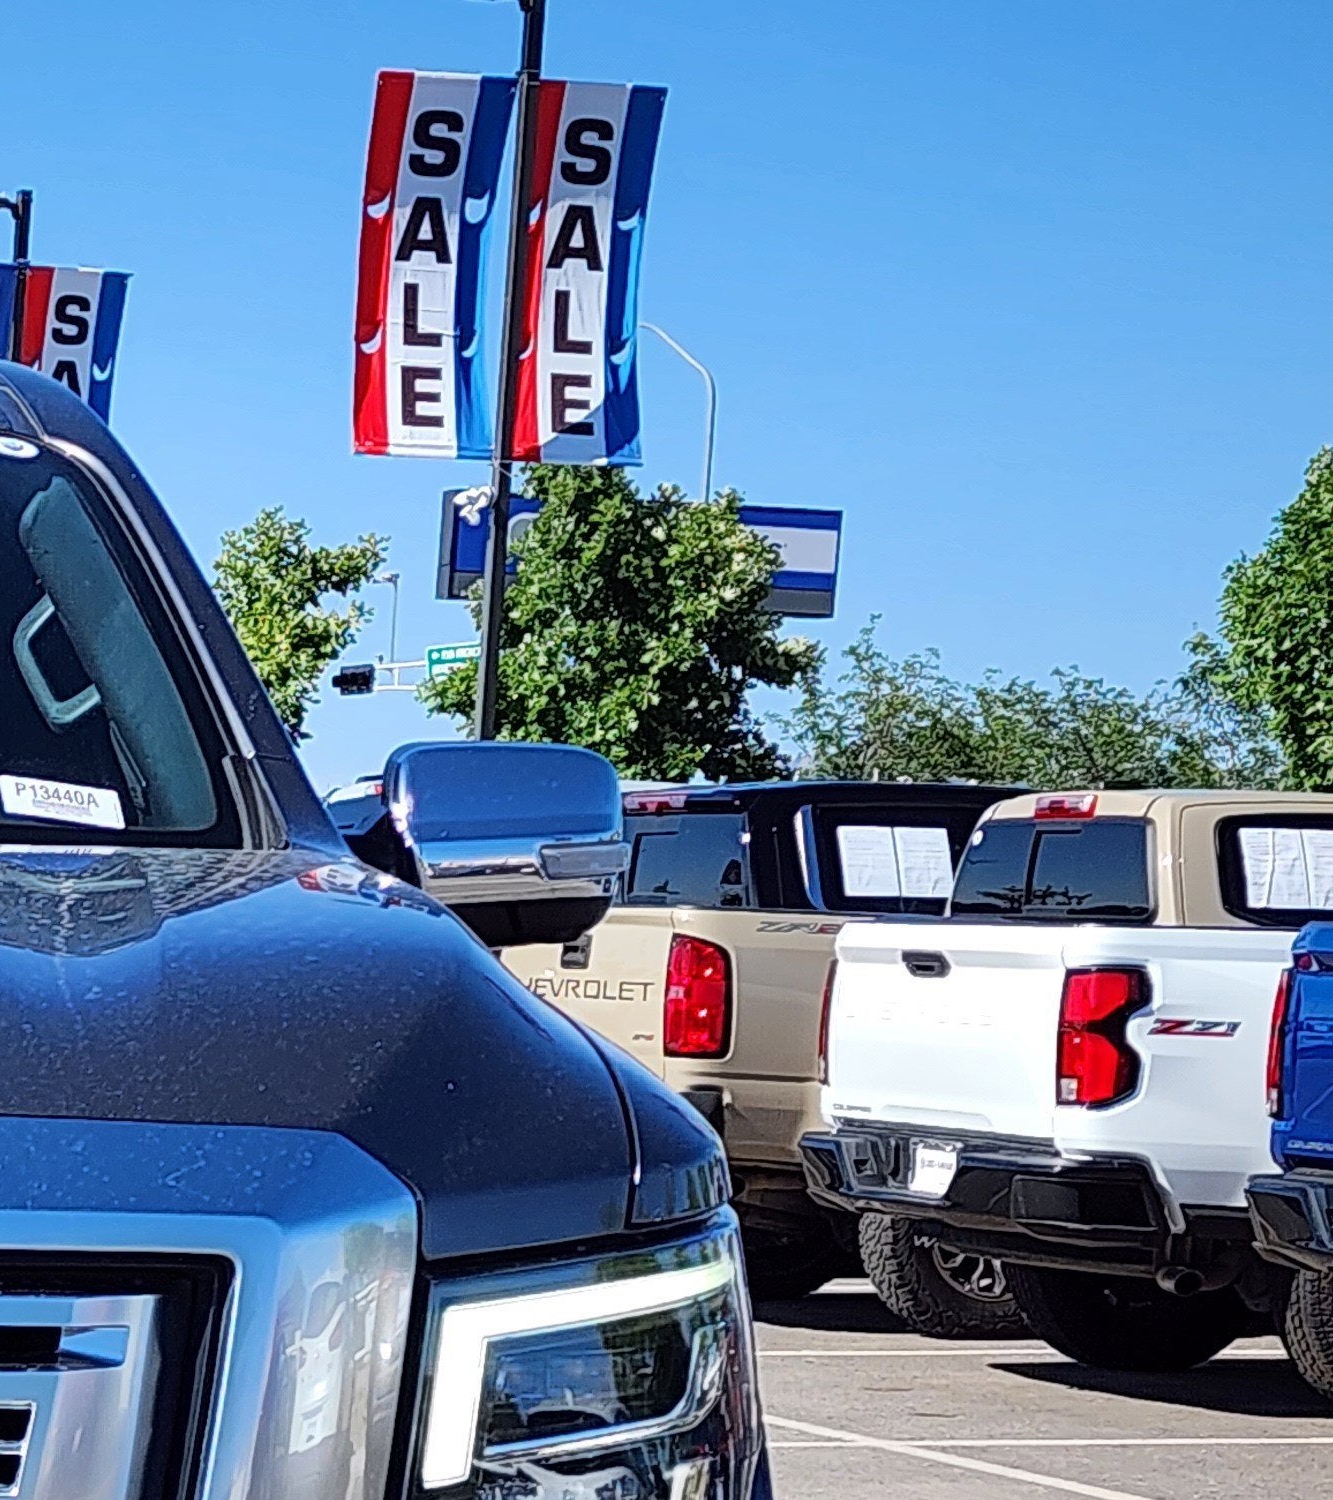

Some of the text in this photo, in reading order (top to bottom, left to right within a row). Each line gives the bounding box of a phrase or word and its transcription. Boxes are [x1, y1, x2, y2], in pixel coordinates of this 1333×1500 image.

[394, 110, 465, 429] SALE
[545, 118, 616, 437] SALE
[15, 782, 100, 809] P13440A
[525, 977, 655, 1002] EVROLET
